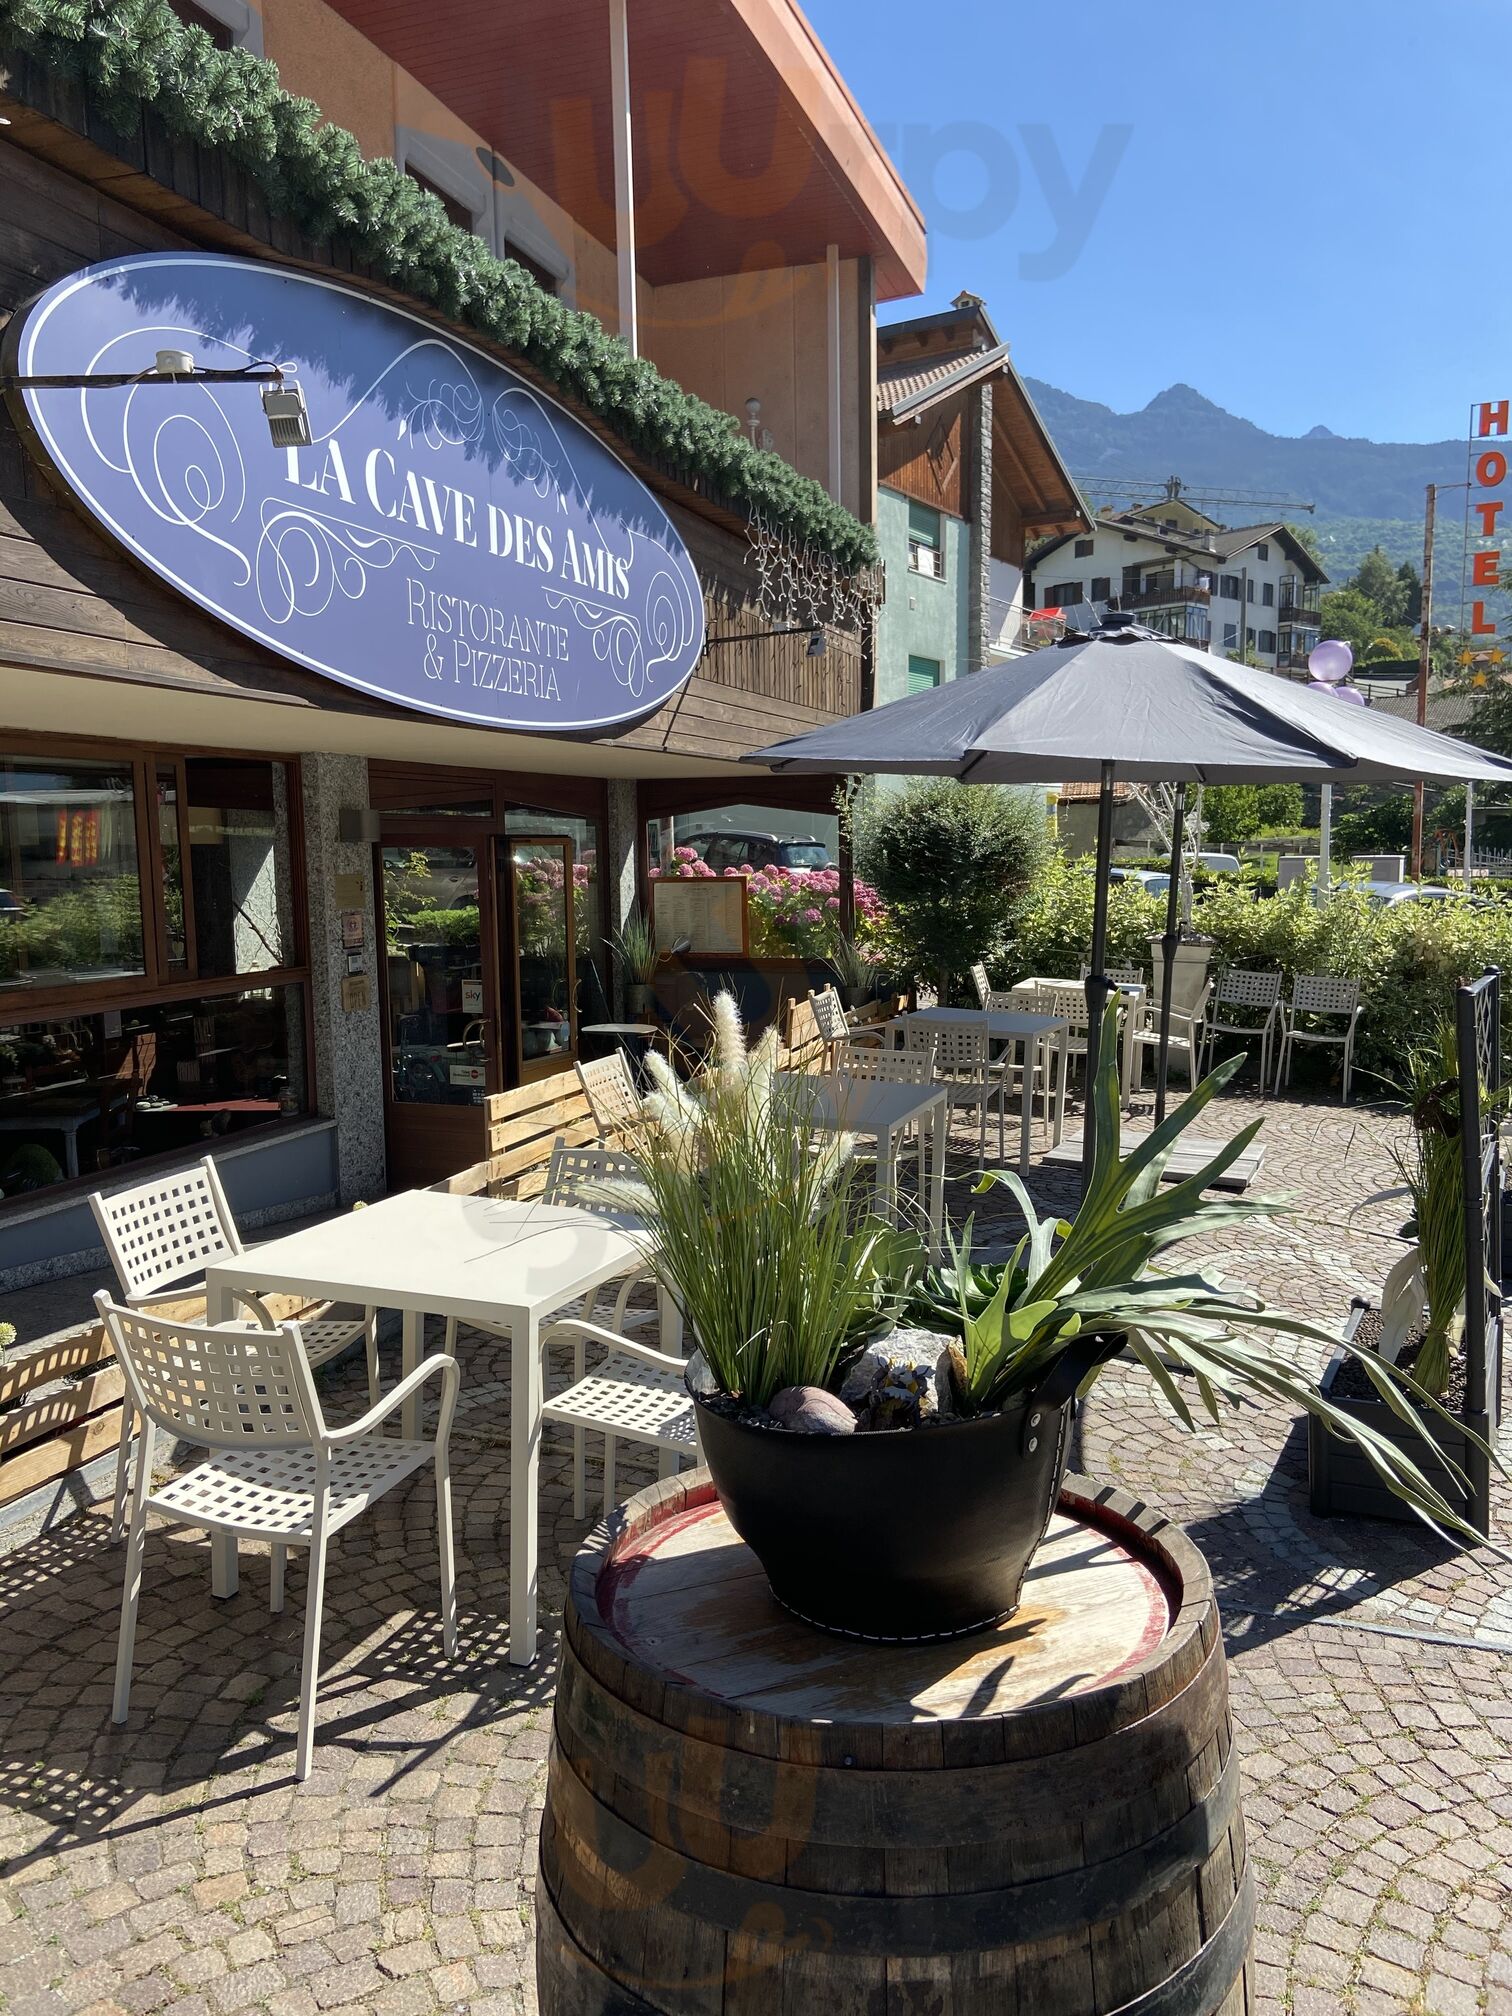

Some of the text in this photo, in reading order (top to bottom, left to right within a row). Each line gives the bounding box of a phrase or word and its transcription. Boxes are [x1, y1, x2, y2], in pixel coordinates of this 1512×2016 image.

[285, 438, 630, 600] LA CAVE DES AMIS
[1472, 400, 1510, 635] HOTEL
[406, 577, 570, 662] RISTORANTE
[423, 633, 563, 702] & PIZZERIA
[465, 989, 481, 1002] sky
